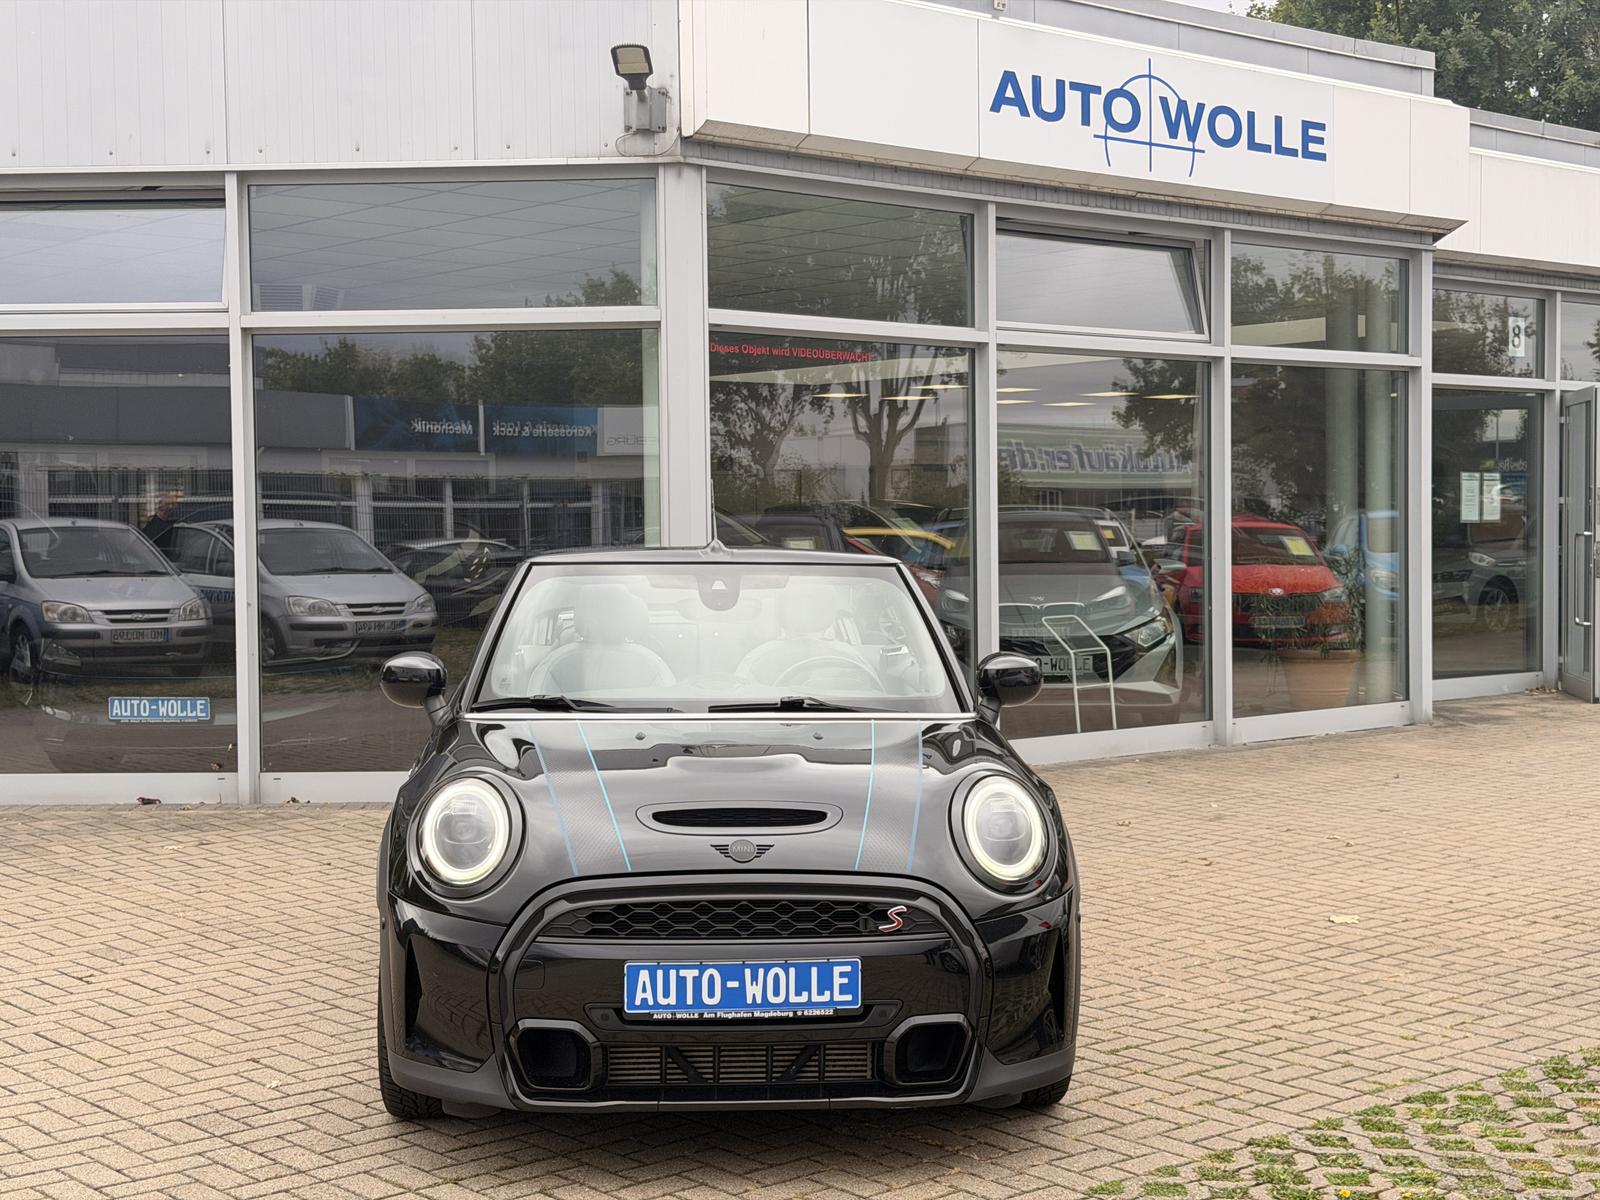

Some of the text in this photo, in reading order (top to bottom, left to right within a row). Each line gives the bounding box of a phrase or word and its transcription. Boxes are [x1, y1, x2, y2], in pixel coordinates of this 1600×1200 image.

[989, 69, 1327, 162] AUTO WOLLE
[1511, 324, 1522, 349] 8
[710, 343, 740, 353] Dieses
[741, 344, 770, 357] Objekt
[771, 347, 790, 357] wird
[112, 698, 207, 717] AUTO-WOLLE
[732, 845, 754, 853] MINI
[878, 905, 907, 933] S
[634, 965, 853, 1006] AUTO-WOLLE
[717, 1011, 752, 1019] Flughafen
[754, 1010, 794, 1018] Magdeburg
